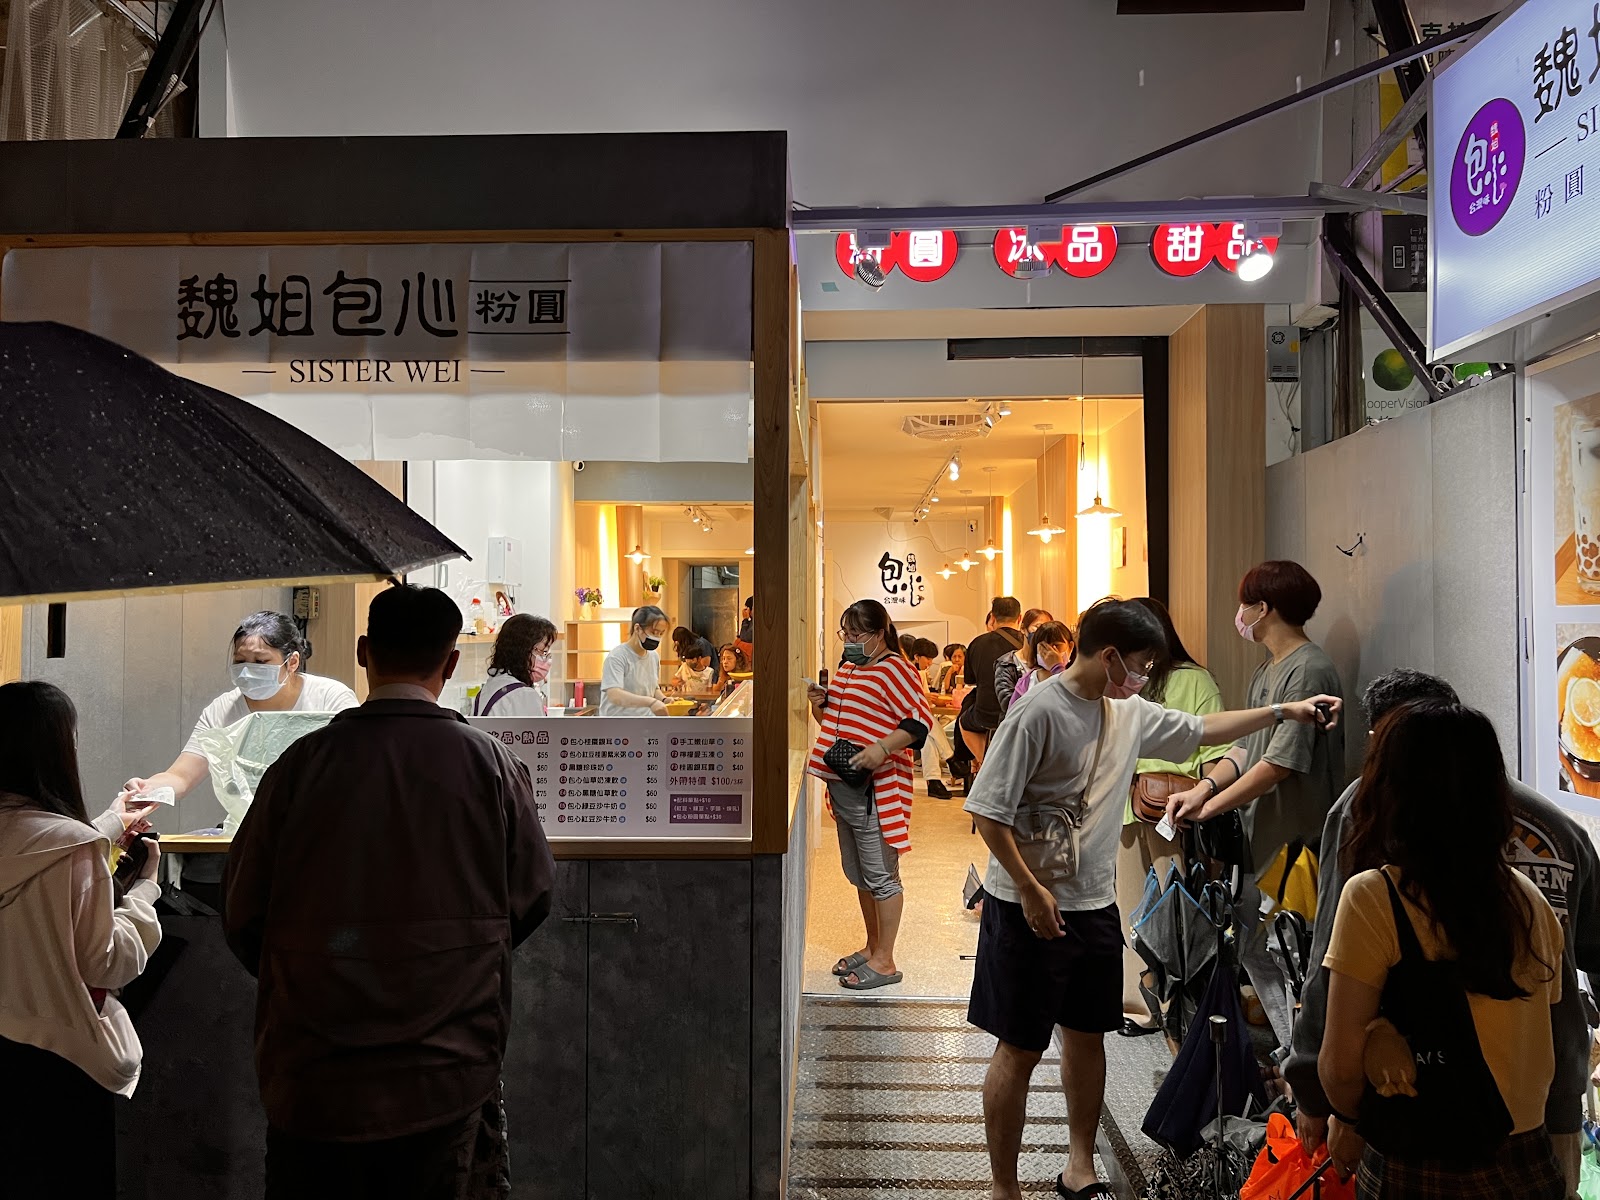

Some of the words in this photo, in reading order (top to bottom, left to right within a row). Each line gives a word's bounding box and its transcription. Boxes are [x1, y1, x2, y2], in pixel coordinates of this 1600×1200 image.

[177, 270, 459, 341] 魏姐包心
[475, 288, 565, 325] 粉圓
[290, 359, 392, 384] SISTER
[397, 359, 460, 384] WEI
[1367, 398, 1429, 411] ooperVision
[487, 730, 549, 745] 品、熱品
